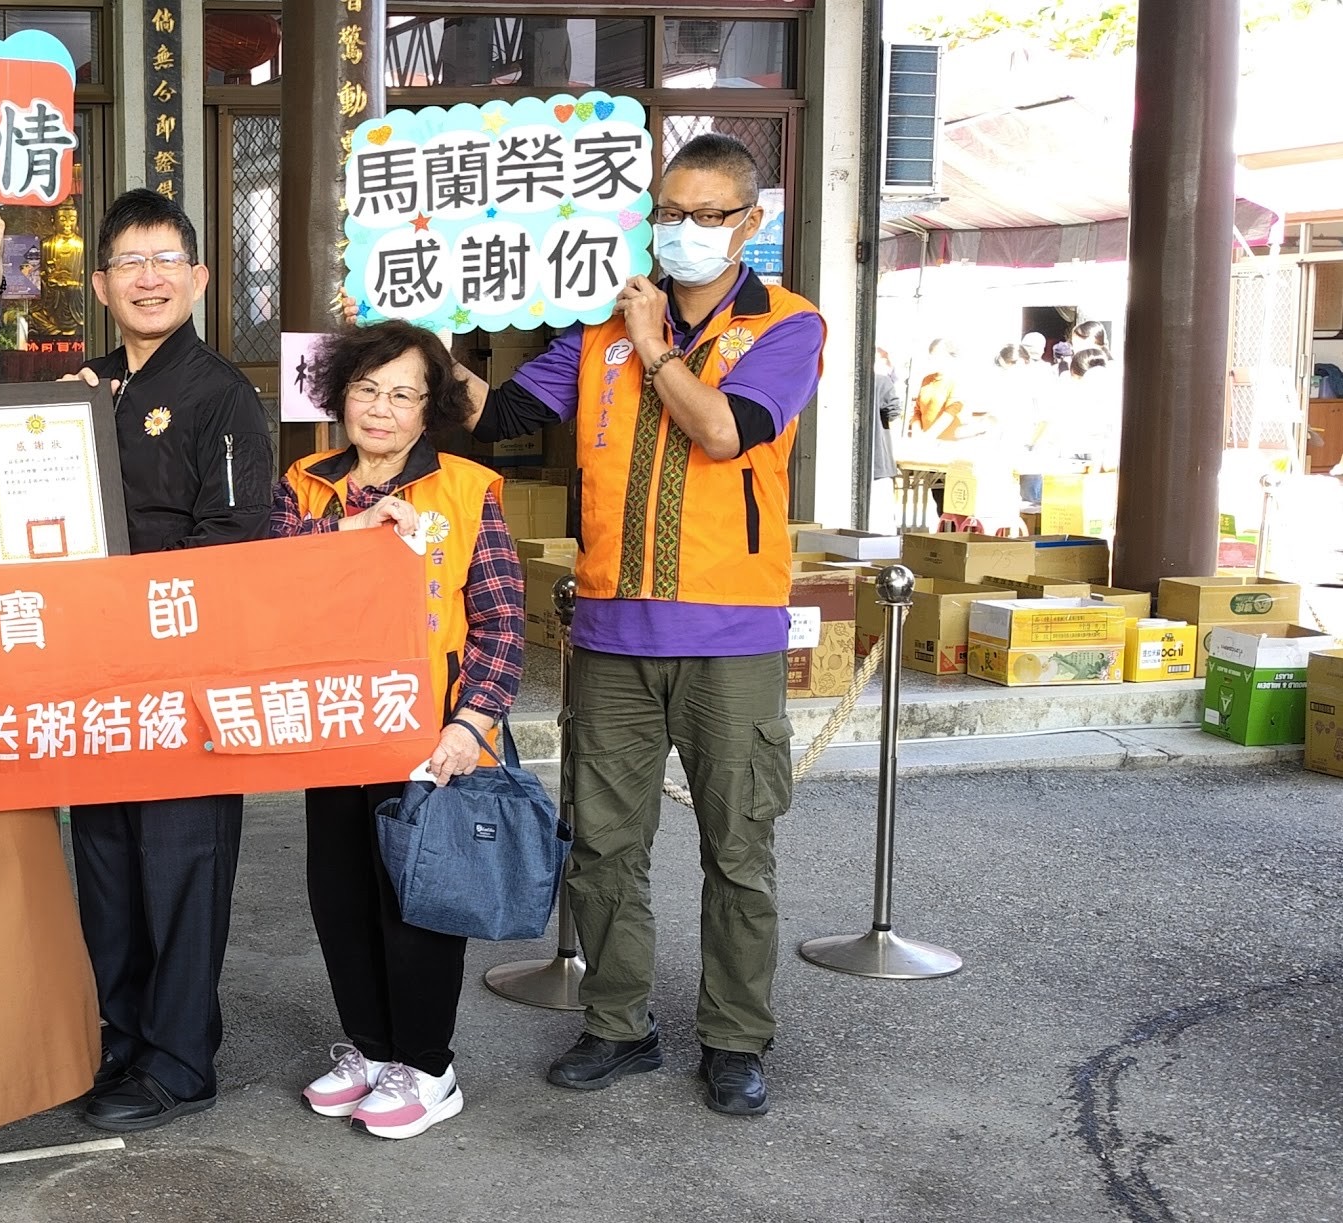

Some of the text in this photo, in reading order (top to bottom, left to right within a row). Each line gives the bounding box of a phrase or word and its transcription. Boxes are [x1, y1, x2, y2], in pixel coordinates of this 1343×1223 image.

[353, 131, 644, 217] 馬蘭榮家
[374, 229, 620, 308] 感謝你
[206, 669, 421, 748] 馬蘭榮家
